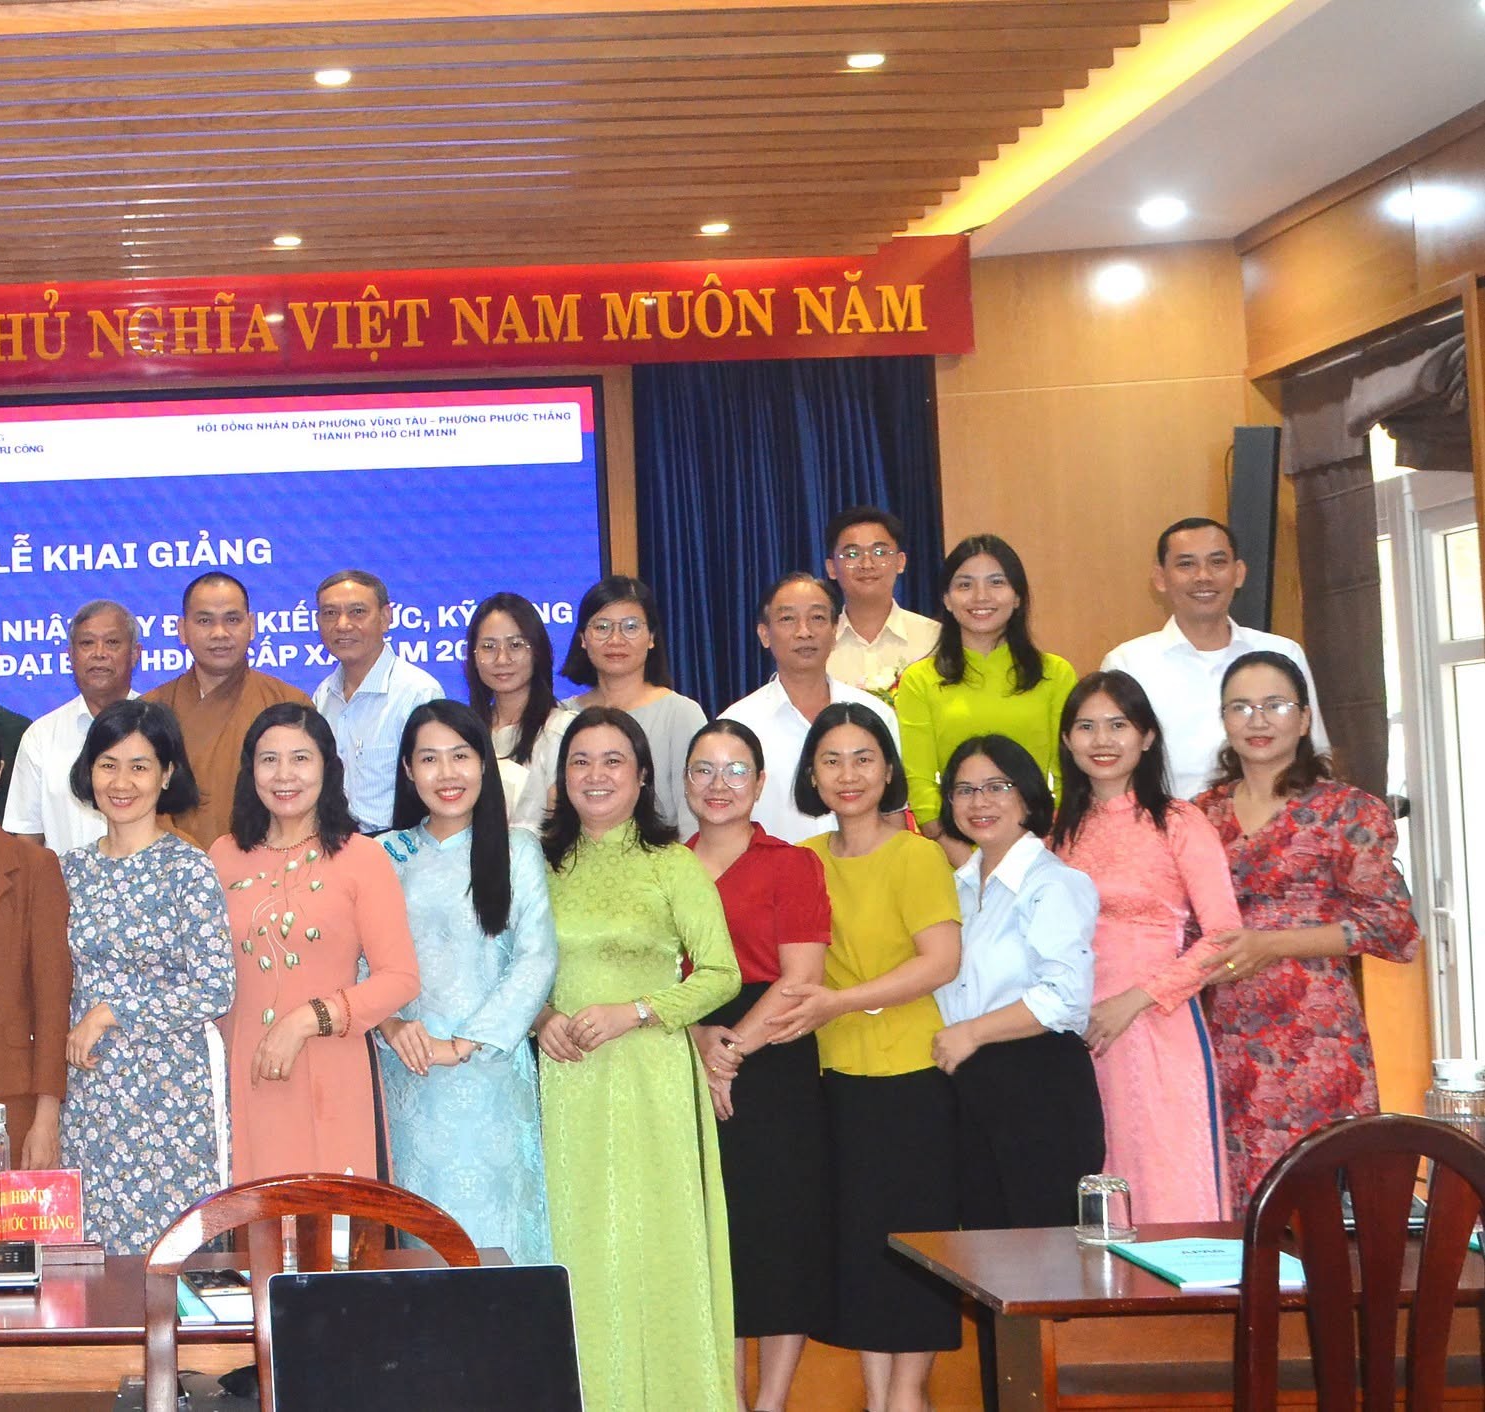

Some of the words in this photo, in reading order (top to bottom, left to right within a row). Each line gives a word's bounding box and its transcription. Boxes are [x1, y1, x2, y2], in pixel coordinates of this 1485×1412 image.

[87, 292, 280, 358] NGHĨA
[288, 284, 430, 363] VIỆT
[450, 293, 584, 346] NAM
[600, 273, 776, 341] MUÔN
[793, 270, 928, 336] NĂM
[424, 427, 457, 438] MINH
[43, 542, 139, 572] KHAI
[148, 530, 273, 567] GIẢNG
[2, 613, 67, 645] NHẬ
